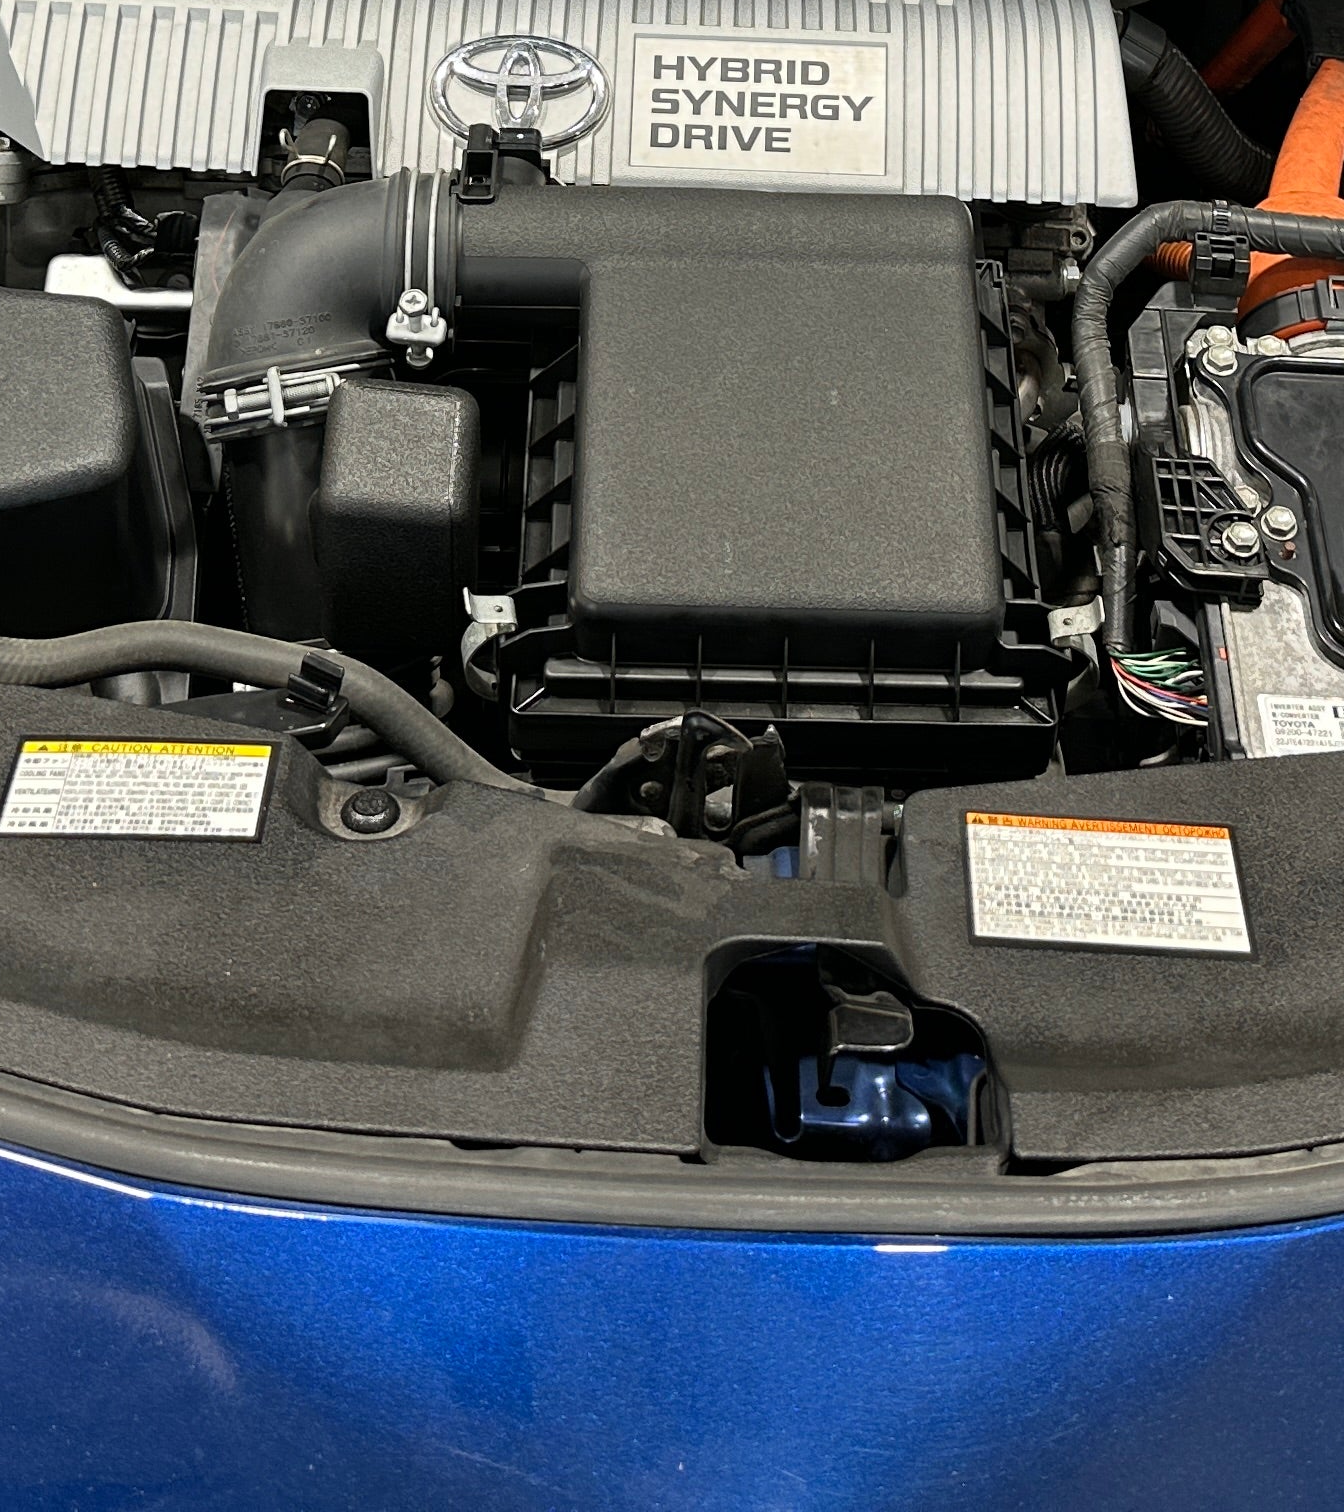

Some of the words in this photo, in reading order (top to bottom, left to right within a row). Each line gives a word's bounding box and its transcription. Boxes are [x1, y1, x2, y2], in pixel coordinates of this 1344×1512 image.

[652, 55, 831, 86] HYBRID
[650, 88, 874, 122] SYNERGY
[649, 122, 792, 153] DRIVE
[1272, 719, 1316, 728] TOYOTA
[91, 743, 153, 753] CAUTION
[159, 744, 236, 755] ATTENTION
[1017, 818, 1067, 829] WARNING
[1071, 820, 1157, 835] AVERTISSEMENT
